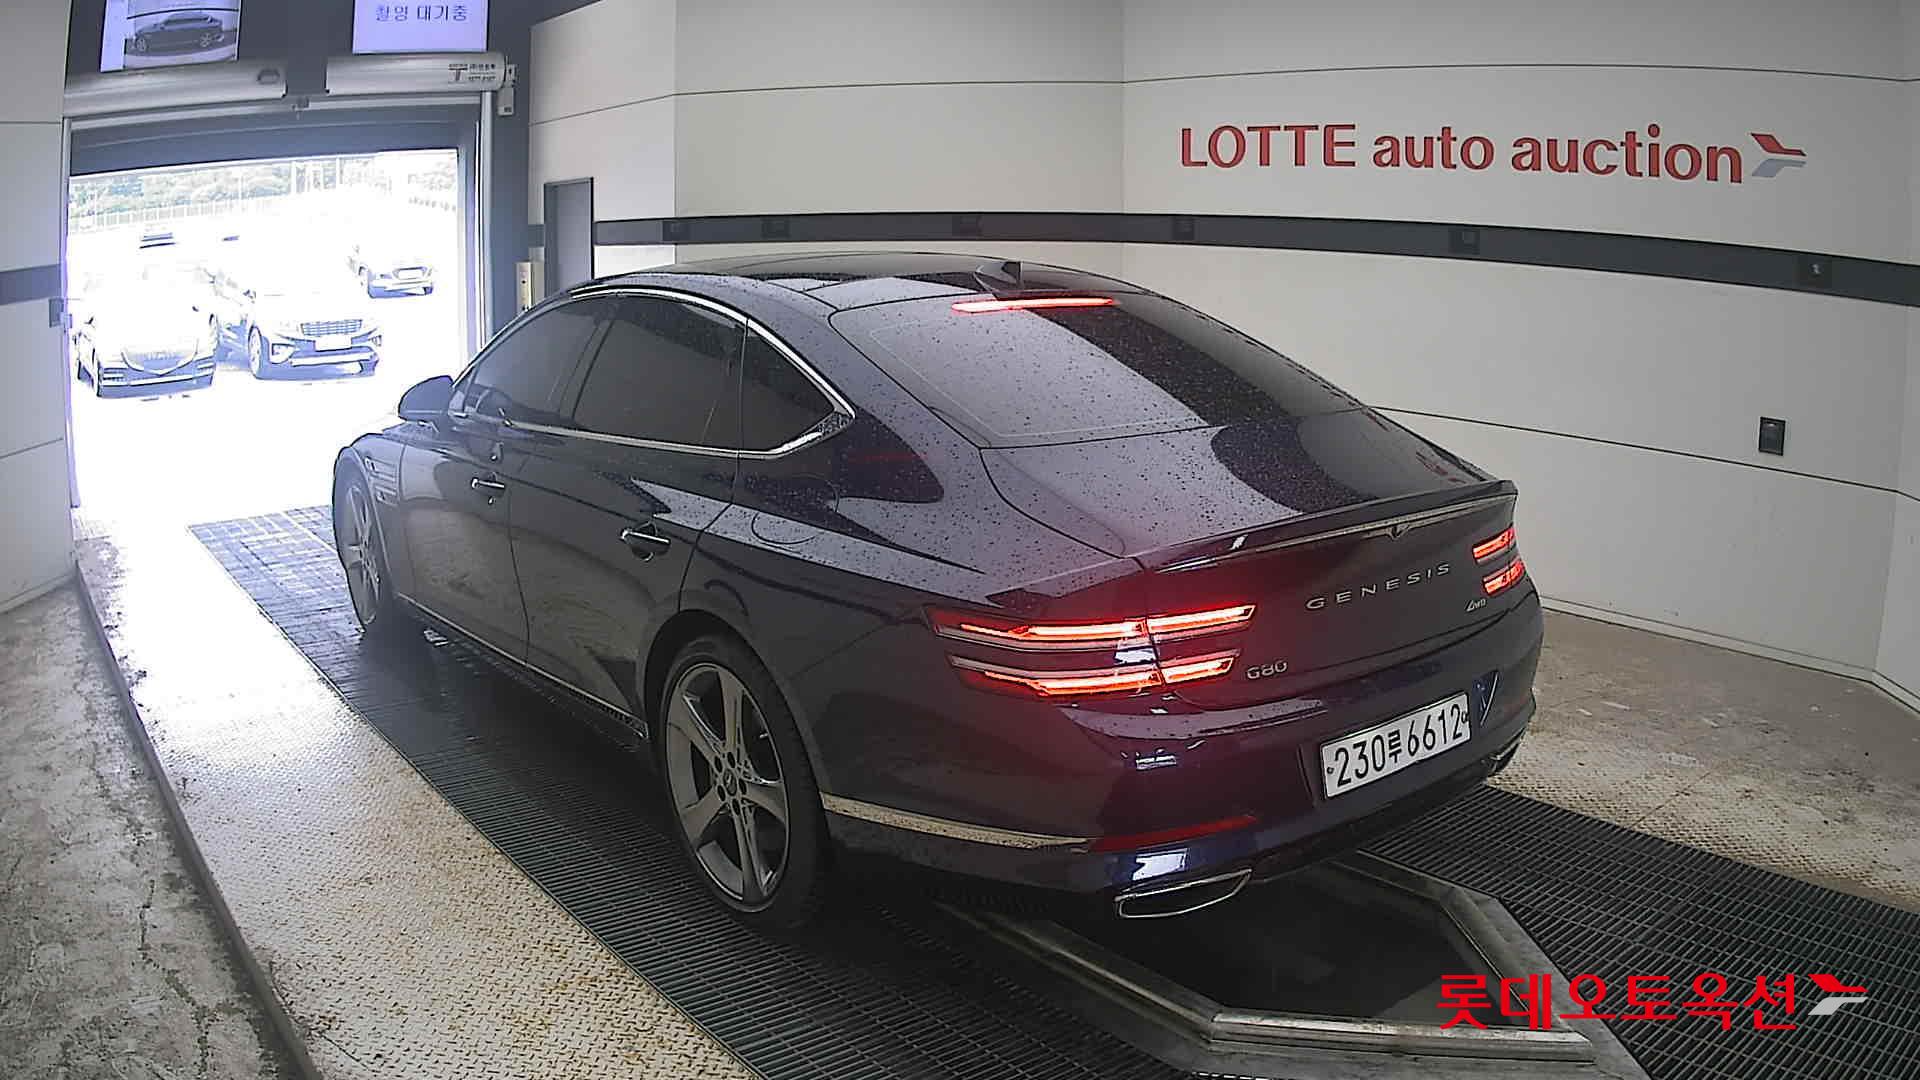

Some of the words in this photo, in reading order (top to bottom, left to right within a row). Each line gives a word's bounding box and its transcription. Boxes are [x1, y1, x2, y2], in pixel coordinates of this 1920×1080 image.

[417, 5, 466, 21] 대기중
[1181, 124, 1356, 168] LOTTE
[1373, 127, 1495, 170] auto
[1511, 123, 1742, 184] auction
[1305, 563, 1450, 610] GENESIS
[1247, 660, 1288, 680] G80
[1335, 703, 1463, 788] 230루6612
